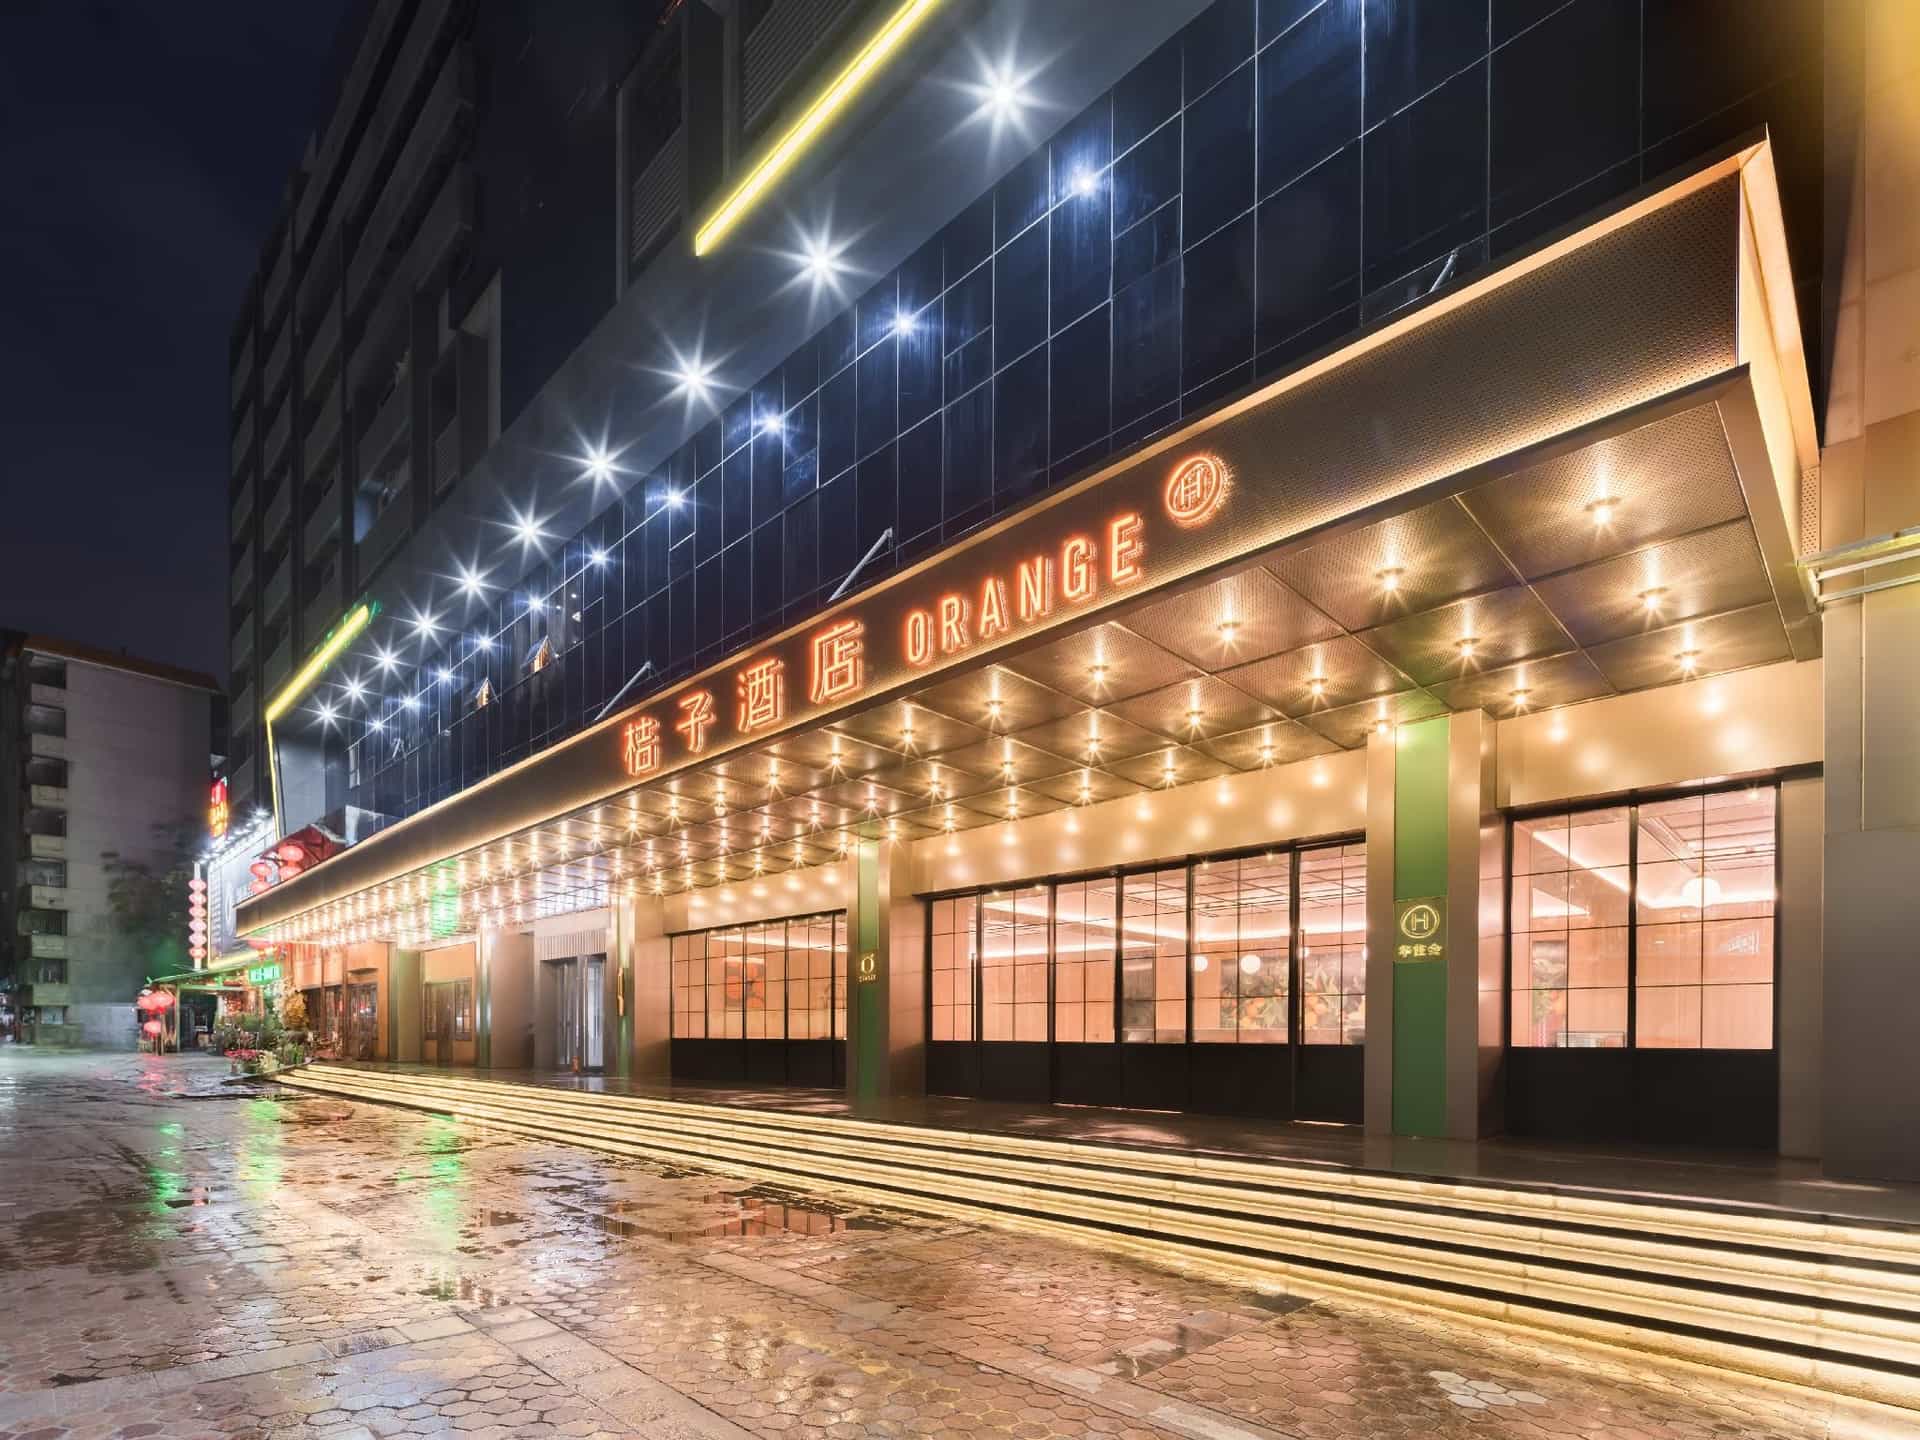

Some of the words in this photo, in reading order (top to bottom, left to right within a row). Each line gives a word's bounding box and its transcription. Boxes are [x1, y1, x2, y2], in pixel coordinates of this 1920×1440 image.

[906, 513, 1144, 666] ORANGE
[623, 620, 865, 777] 桔子酒店
